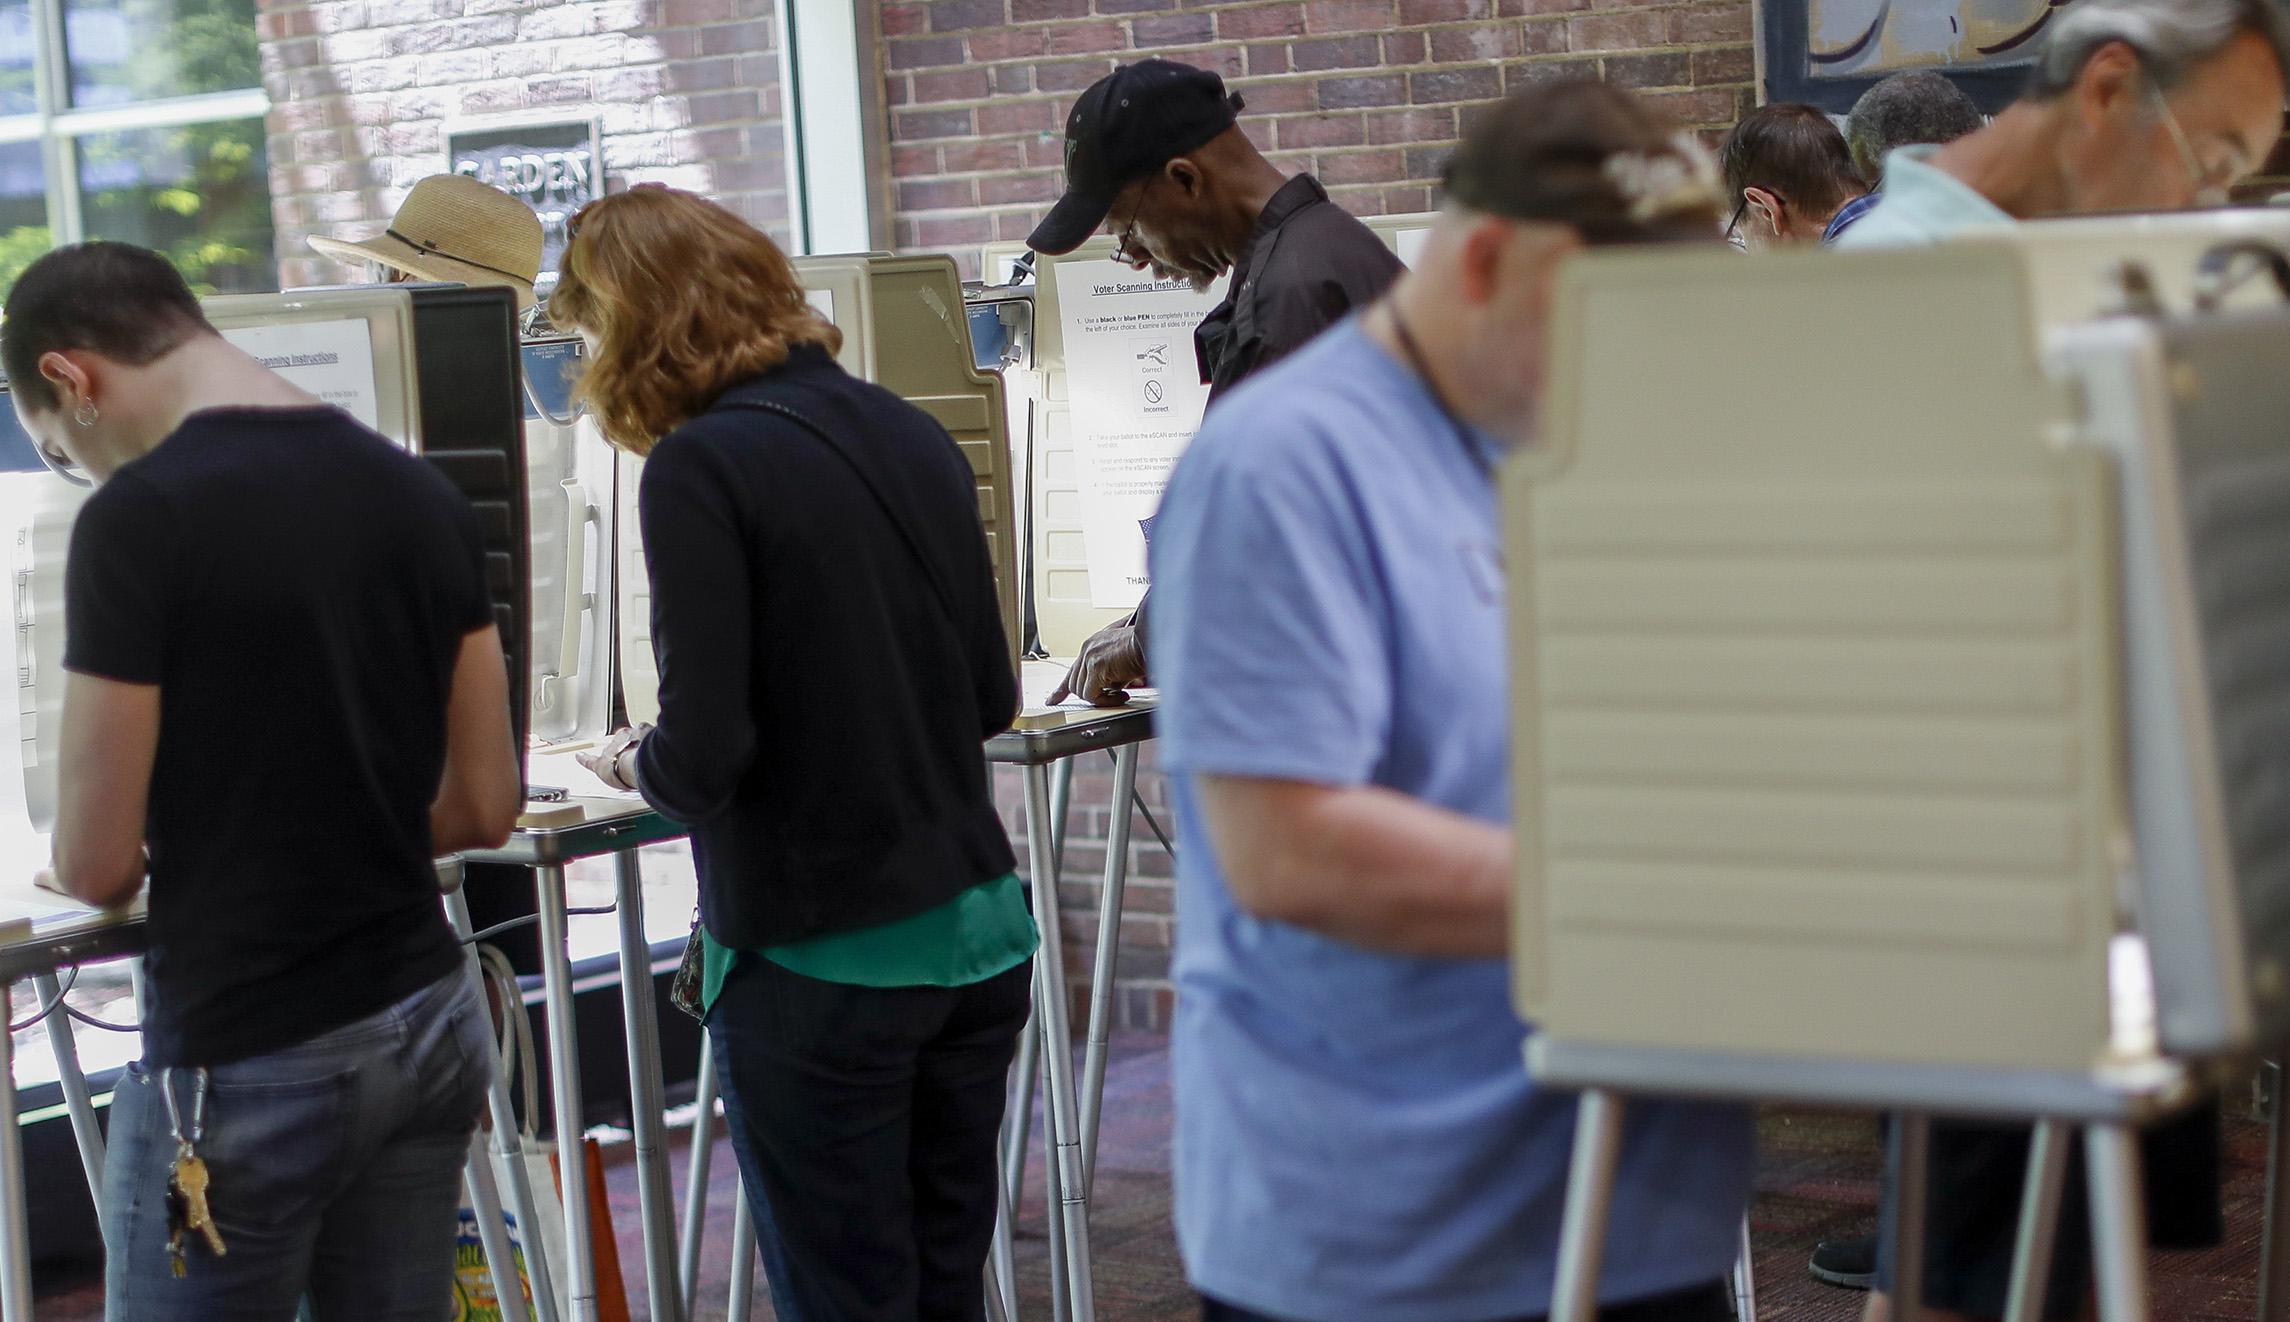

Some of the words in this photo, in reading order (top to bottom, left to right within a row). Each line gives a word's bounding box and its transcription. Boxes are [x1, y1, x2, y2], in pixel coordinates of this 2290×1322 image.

[1093, 285, 1115, 293] Voter
[1116, 282, 1153, 292] Scanning
[1154, 278, 1192, 289] Instructio
[255, 354, 291, 366] anning
[1141, 366, 1163, 374] Correct
